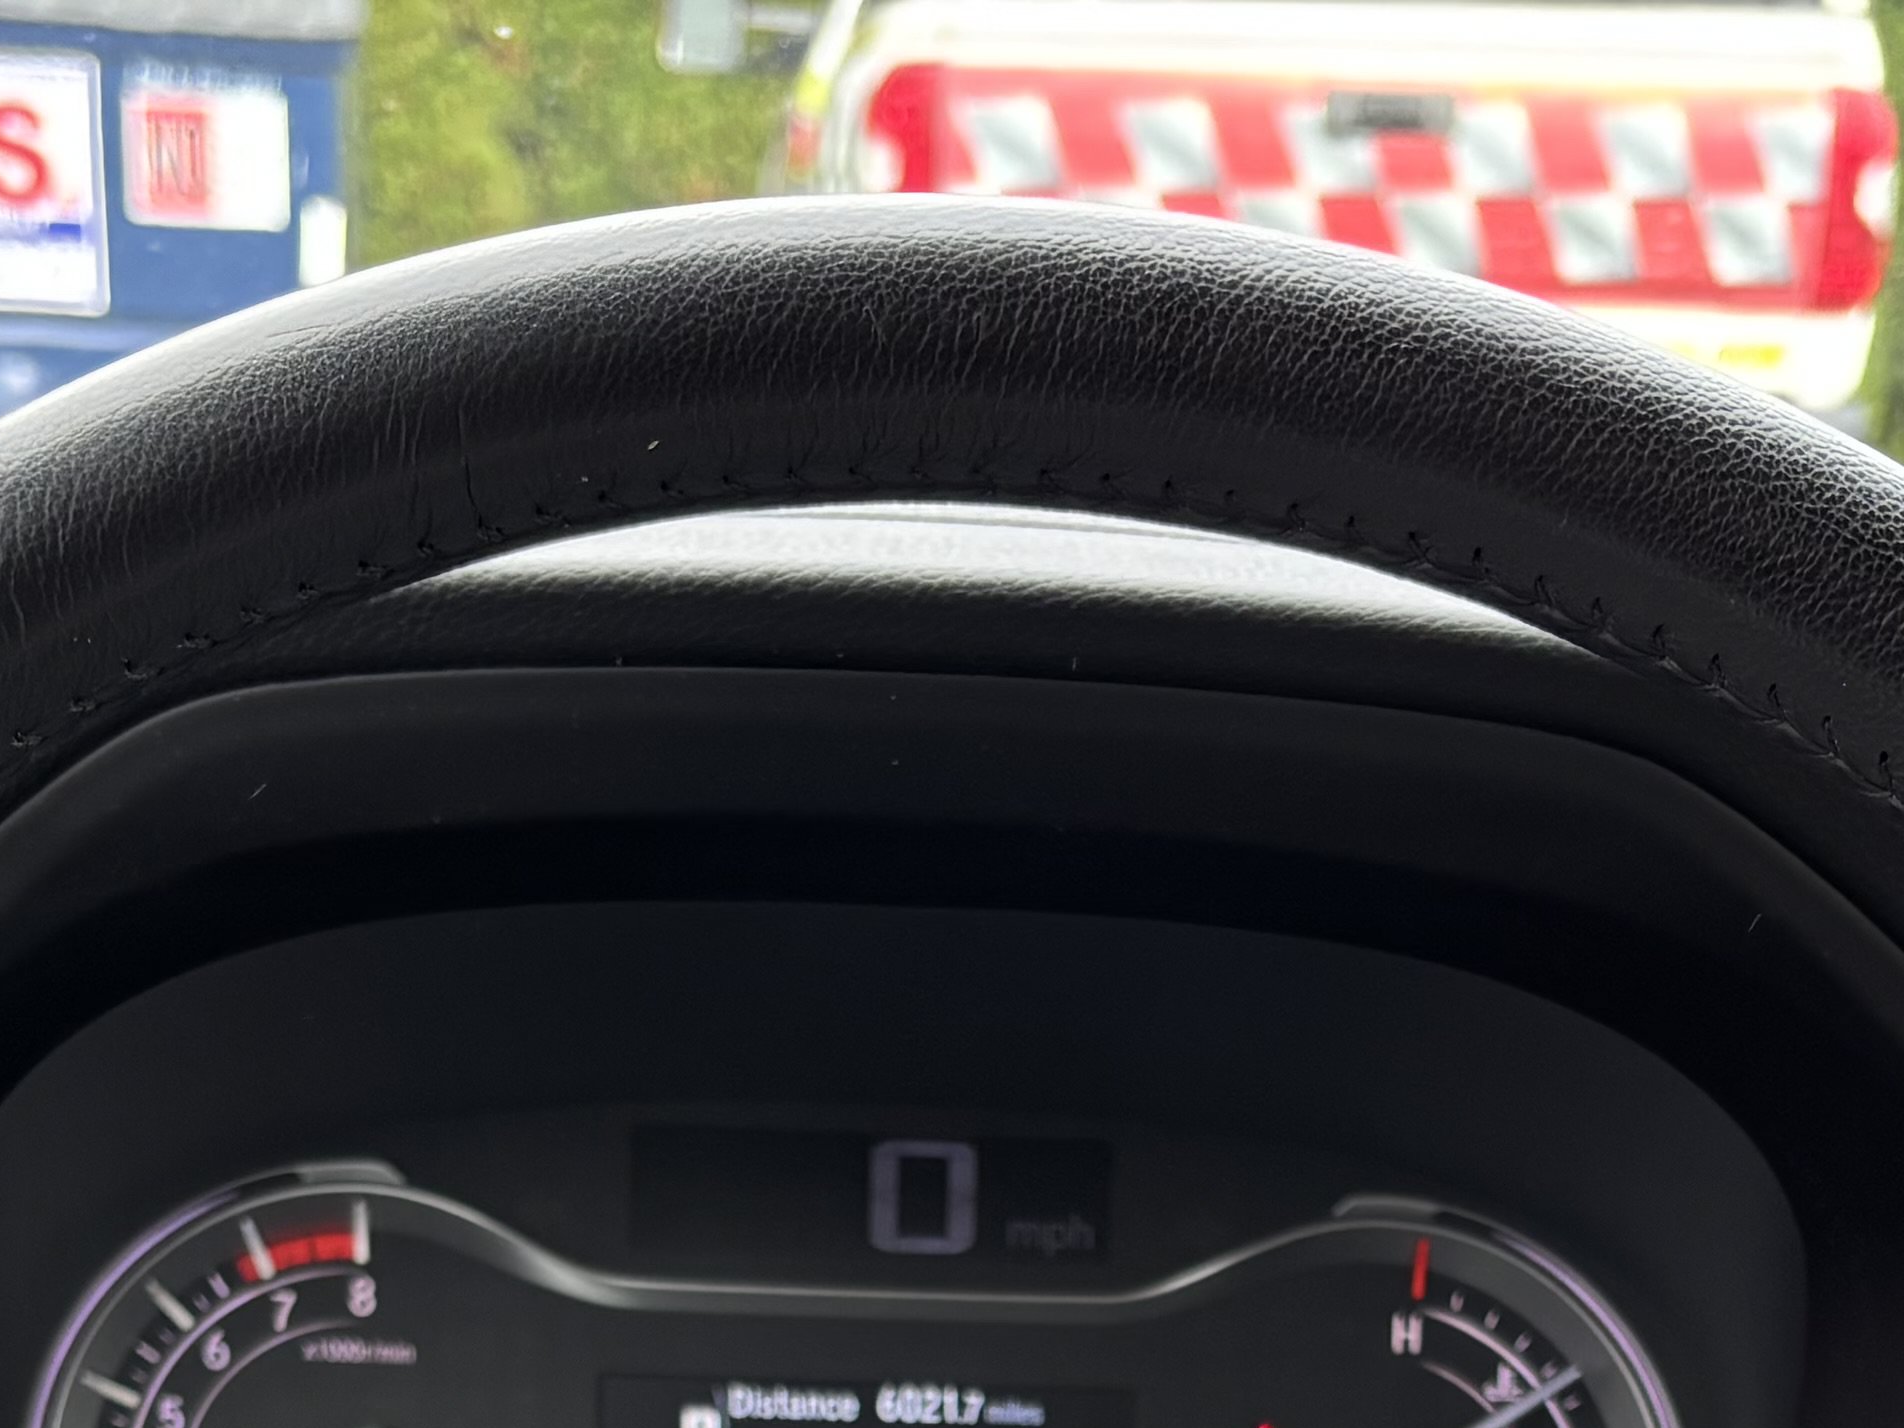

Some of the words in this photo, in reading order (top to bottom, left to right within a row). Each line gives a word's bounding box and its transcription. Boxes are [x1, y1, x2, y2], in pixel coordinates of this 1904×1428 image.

[867, 1140, 978, 1256] 0
[270, 1287, 299, 1333] 7
[347, 1275, 377, 1318] 8
[202, 1331, 231, 1371] 6
[1390, 1312, 1423, 1355] H
[727, 1381, 862, 1422] Distance
